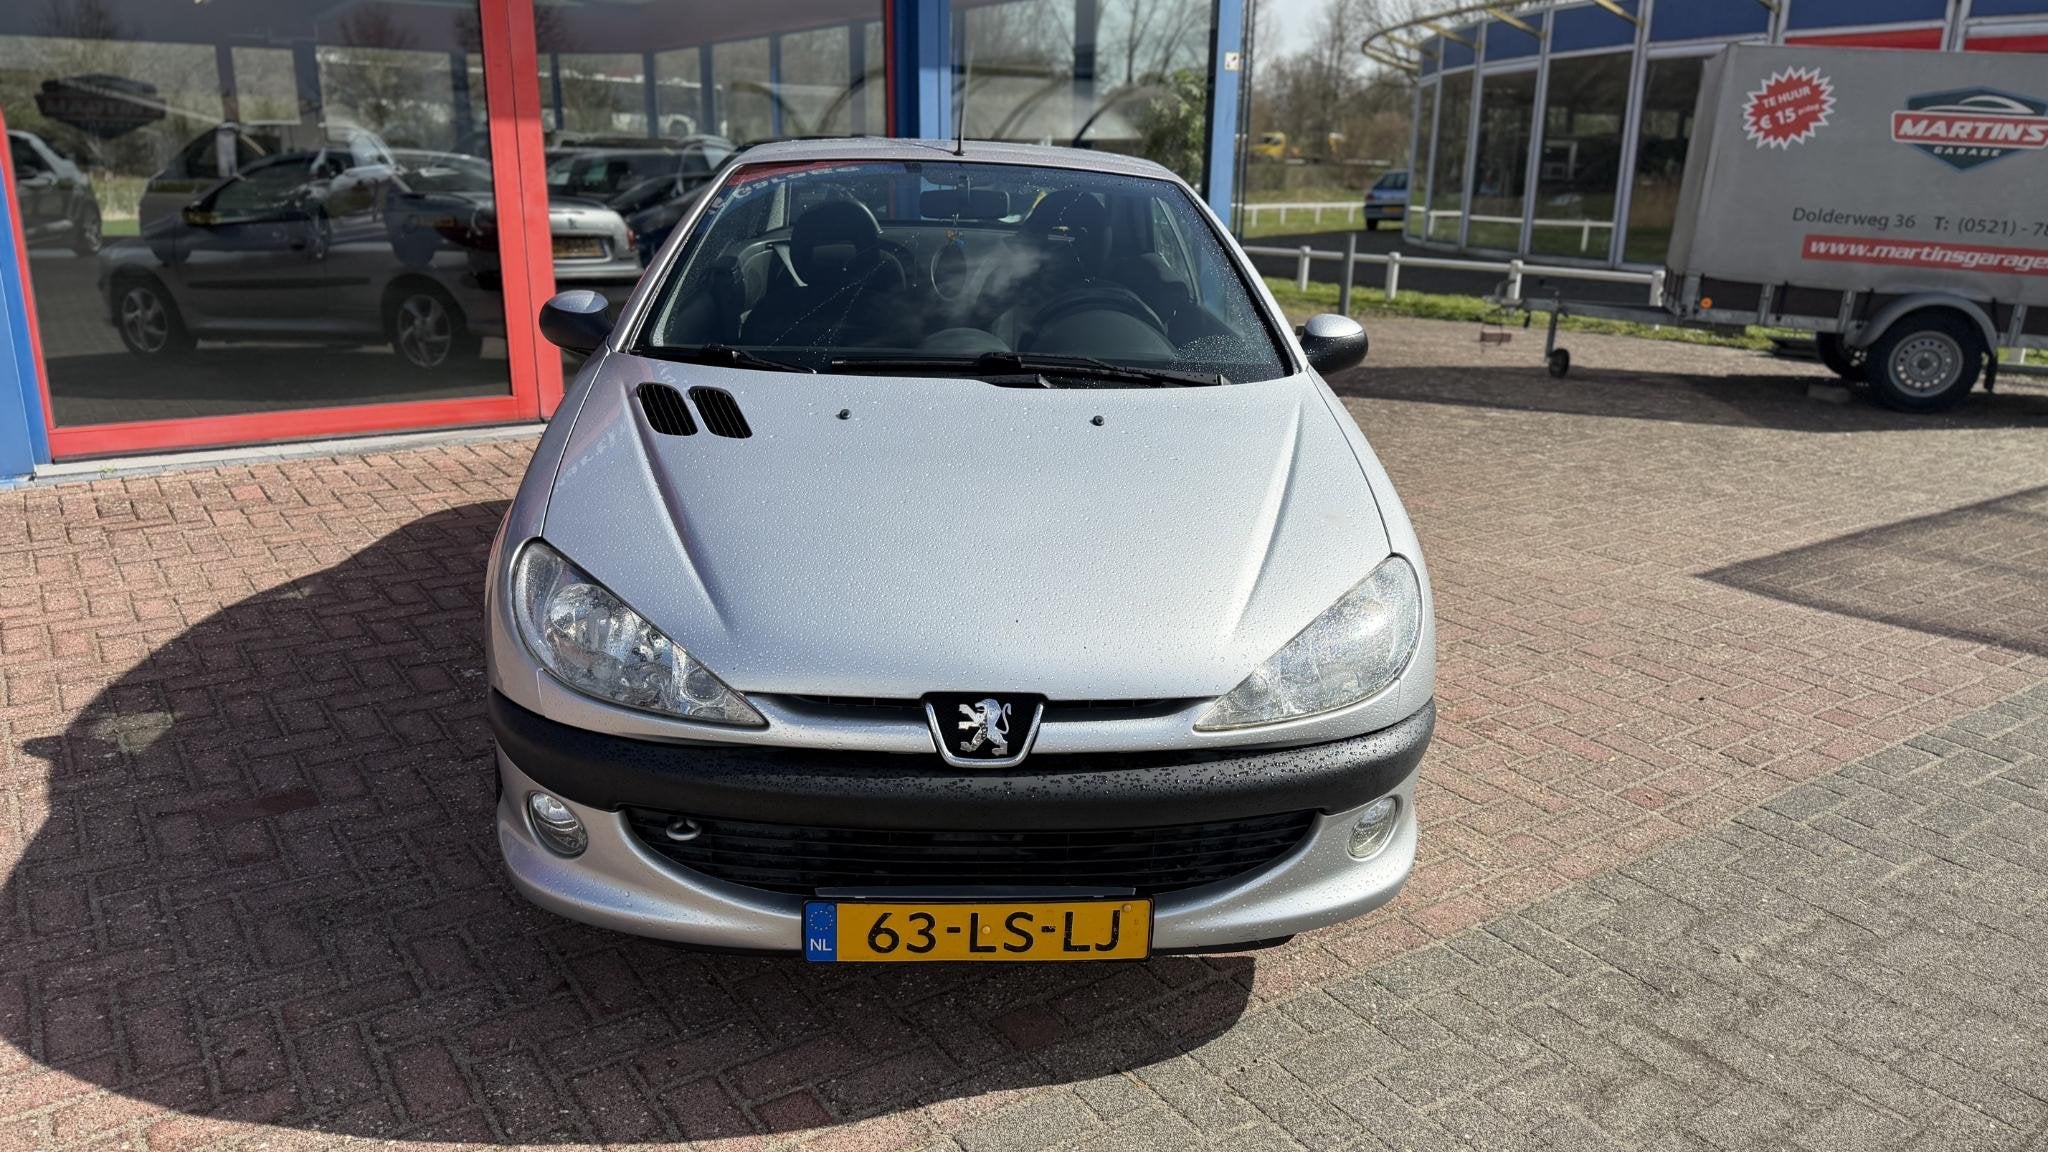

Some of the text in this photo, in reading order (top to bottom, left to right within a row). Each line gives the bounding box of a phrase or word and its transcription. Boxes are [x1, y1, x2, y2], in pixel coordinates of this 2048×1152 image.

[1763, 86, 1811, 108] TE HUUR
[1760, 114, 1772, 129] €
[1775, 107, 1796, 125] 15
[1933, 146, 2002, 157] GARAGE
[1792, 206, 1890, 231] Dolderweg
[1893, 213, 1917, 229] 36
[1934, 216, 1949, 231] T:
[1958, 217, 2017, 237] (0521)
[867, 910, 1121, 953] 63-LS-LJ
[810, 938, 832, 952] NL
